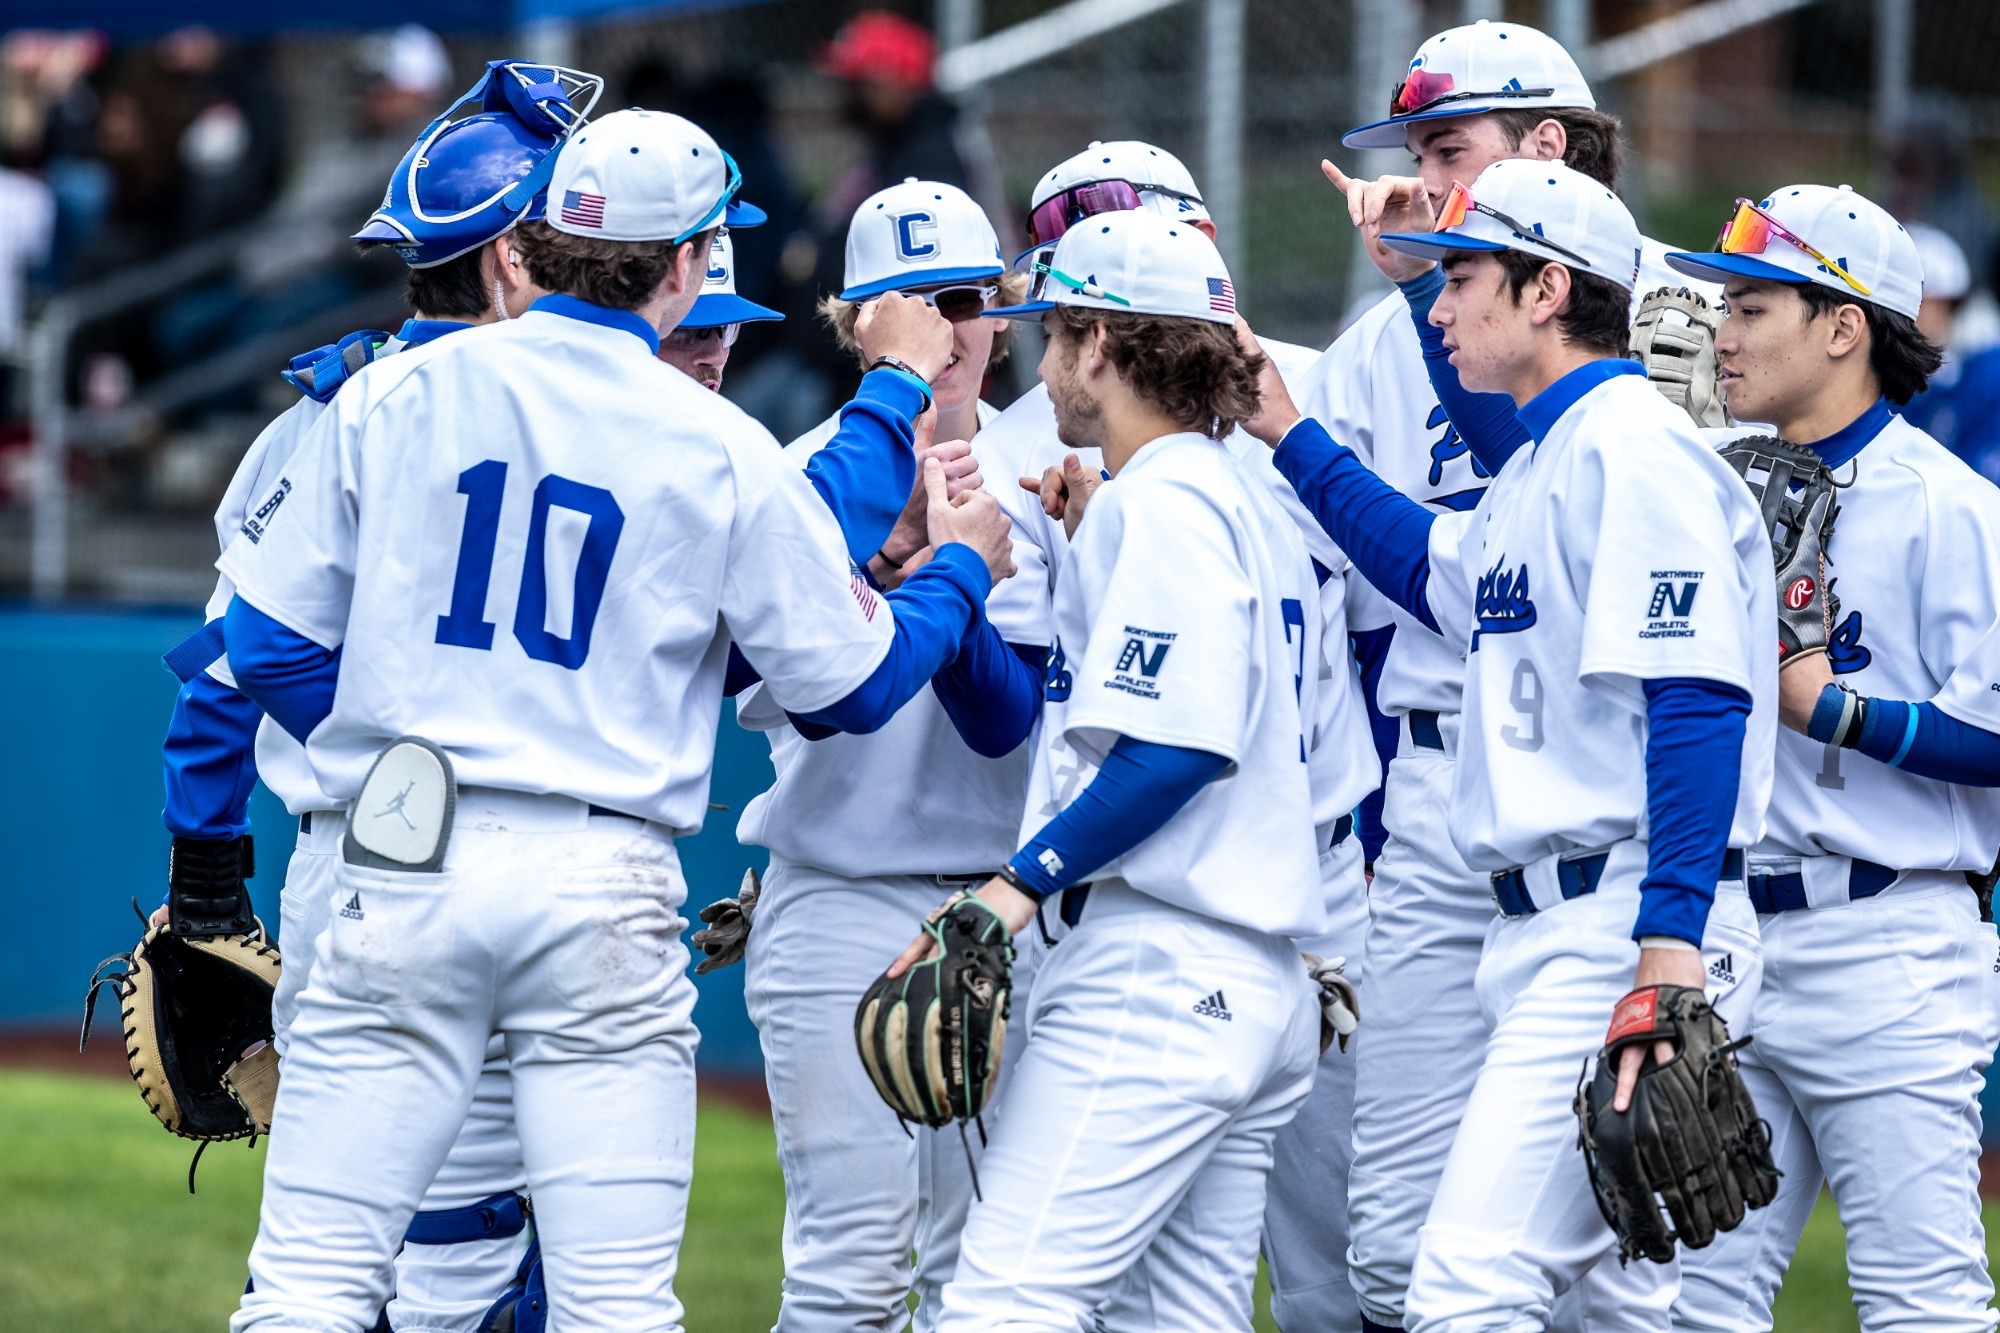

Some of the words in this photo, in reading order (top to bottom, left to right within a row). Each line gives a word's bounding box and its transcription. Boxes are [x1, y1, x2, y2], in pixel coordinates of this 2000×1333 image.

[891, 209, 941, 264] C
[435, 459, 625, 670] 10
[1649, 571, 1704, 580] NORTHWEST
[1647, 582, 1699, 617] N
[1124, 625, 1178, 640] NORTHWEST
[1638, 629, 1696, 639] CONFERENCE
[1647, 621, 1689, 630] ATHLETIC
[1115, 638, 1170, 678] N
[1103, 680, 1161, 700] CONFERENCE
[1114, 674, 1156, 689] ATHLETIC
[1500, 658, 1545, 752] 9
[1708, 966, 1736, 985] adidas
[1193, 1004, 1233, 1021] adidas
